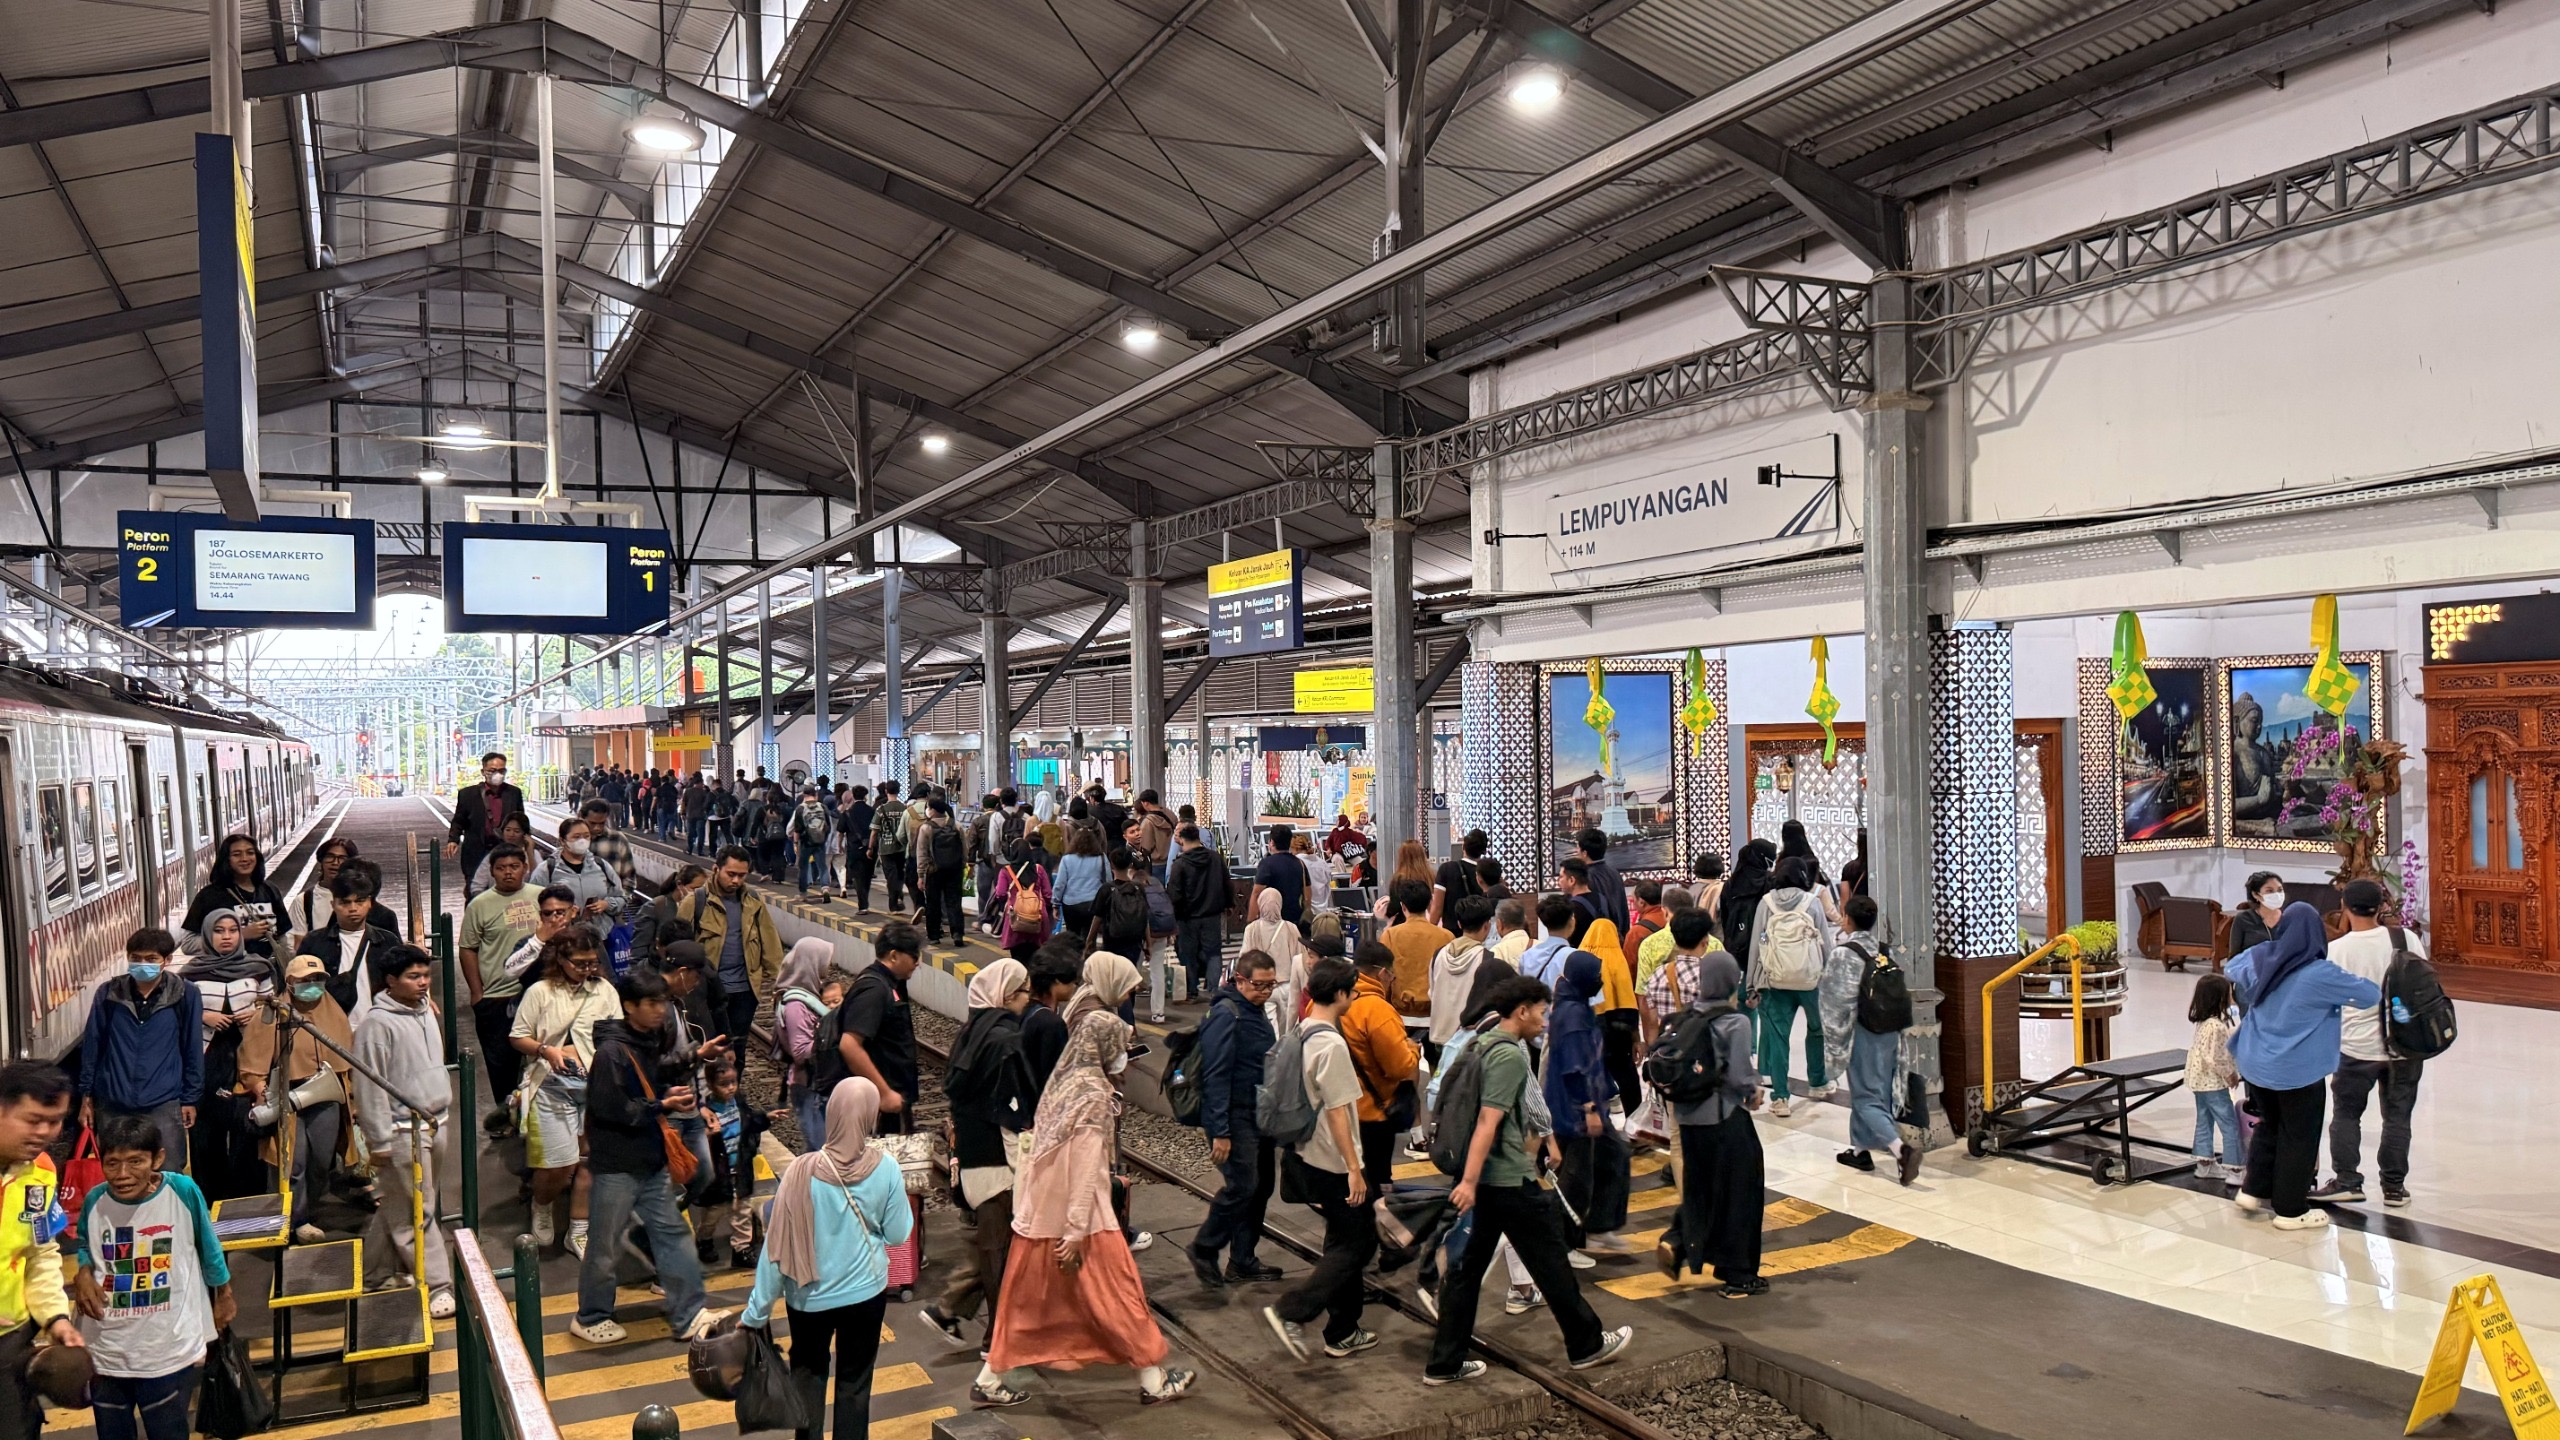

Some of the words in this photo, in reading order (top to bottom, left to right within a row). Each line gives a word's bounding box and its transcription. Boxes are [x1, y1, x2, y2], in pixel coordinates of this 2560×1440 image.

[1559, 477, 1728, 537] LEMPUYANGAN
[124, 529, 170, 543] Peron
[127, 542, 169, 552] Platform
[209, 540, 226, 548] 187
[1569, 544, 1584, 557] 114
[1586, 541, 1596, 556] M
[209, 549, 324, 561] JOGLOSEMARKERTO
[630, 546, 665, 558] Peron
[630, 558, 661, 567] Platform
[137, 557, 158, 582] 2
[1242, 566, 1250, 575] KA
[209, 572, 265, 580] SEMARANG
[267, 573, 310, 582] TAWANG
[642, 571, 654, 592] 1
[1262, 621, 1274, 631] Toilet
[2481, 1311, 2508, 1328] CAUTION
[2482, 1329, 2496, 1341] WET
[2498, 1321, 2515, 1336] FLOOR
[2513, 1401, 2536, 1417] LANTAI
